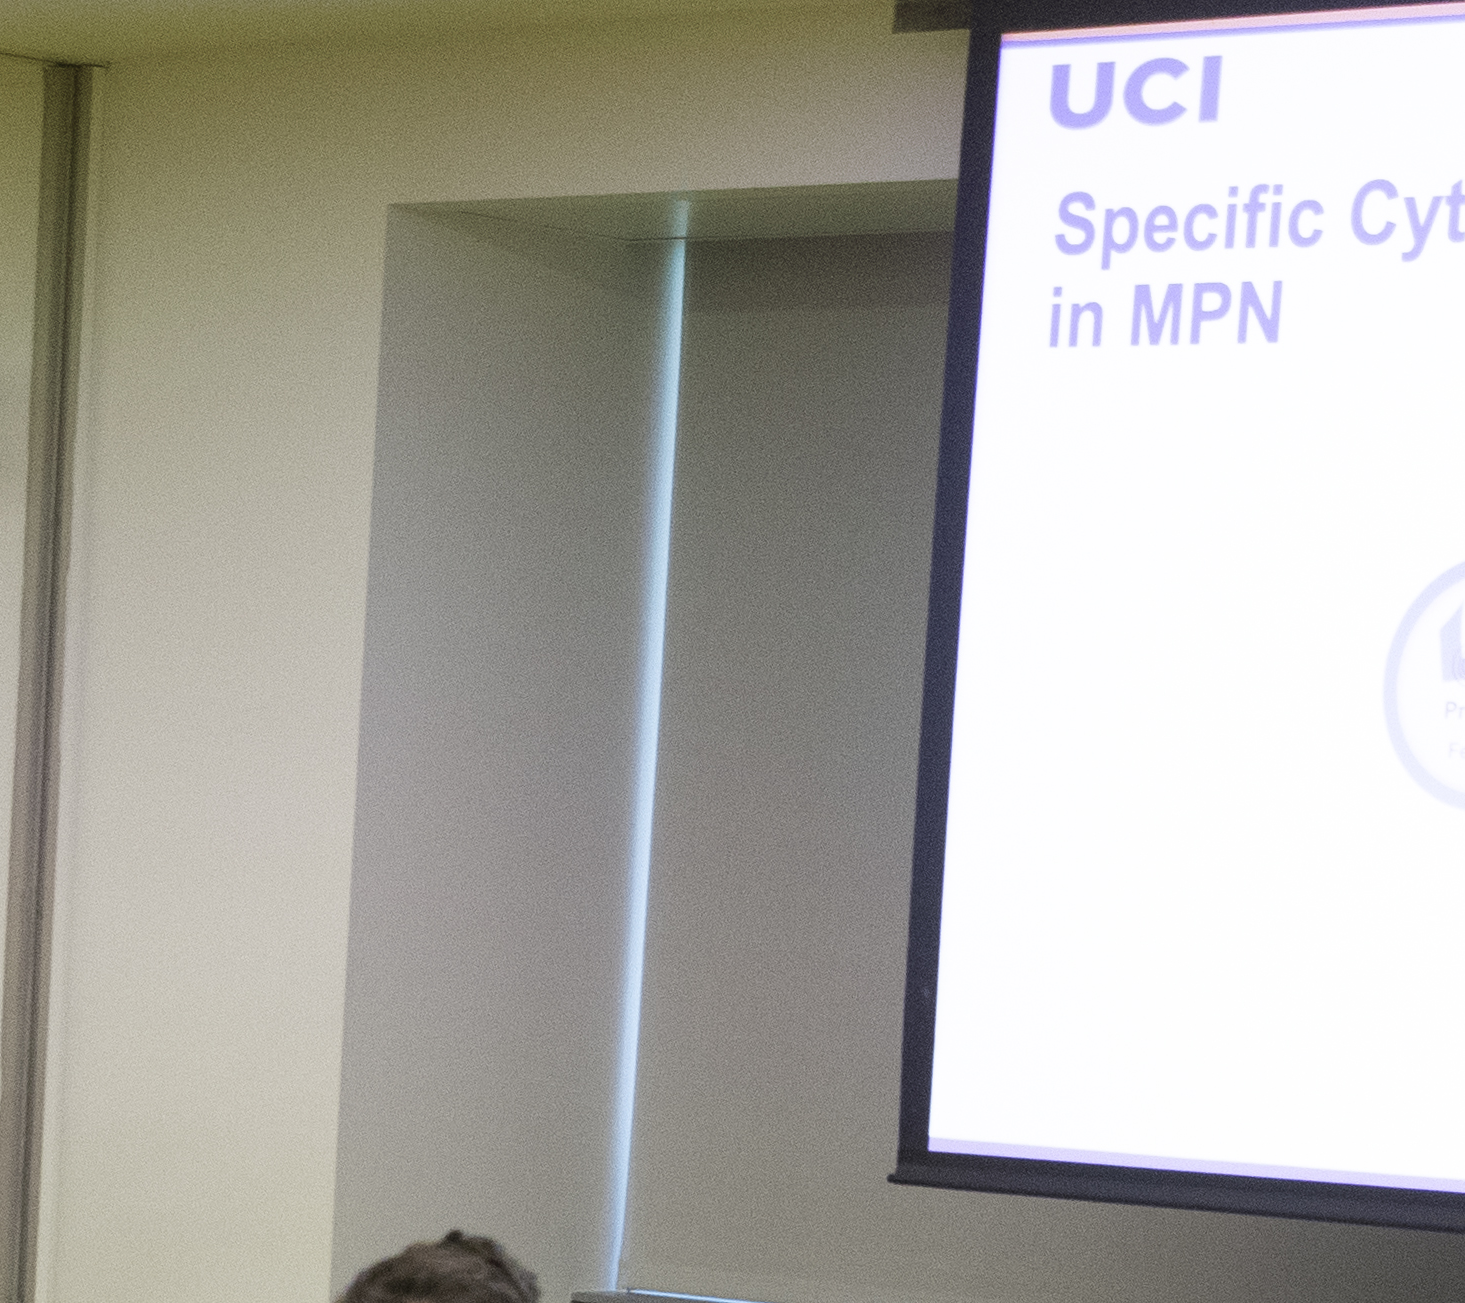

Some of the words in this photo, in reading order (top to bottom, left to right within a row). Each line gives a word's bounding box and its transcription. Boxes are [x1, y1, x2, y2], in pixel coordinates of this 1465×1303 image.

[1047, 51, 1224, 133] UCI
[1050, 182, 1327, 271] Specific
[1047, 286, 1110, 353] in
[1126, 279, 1286, 352] MPN
